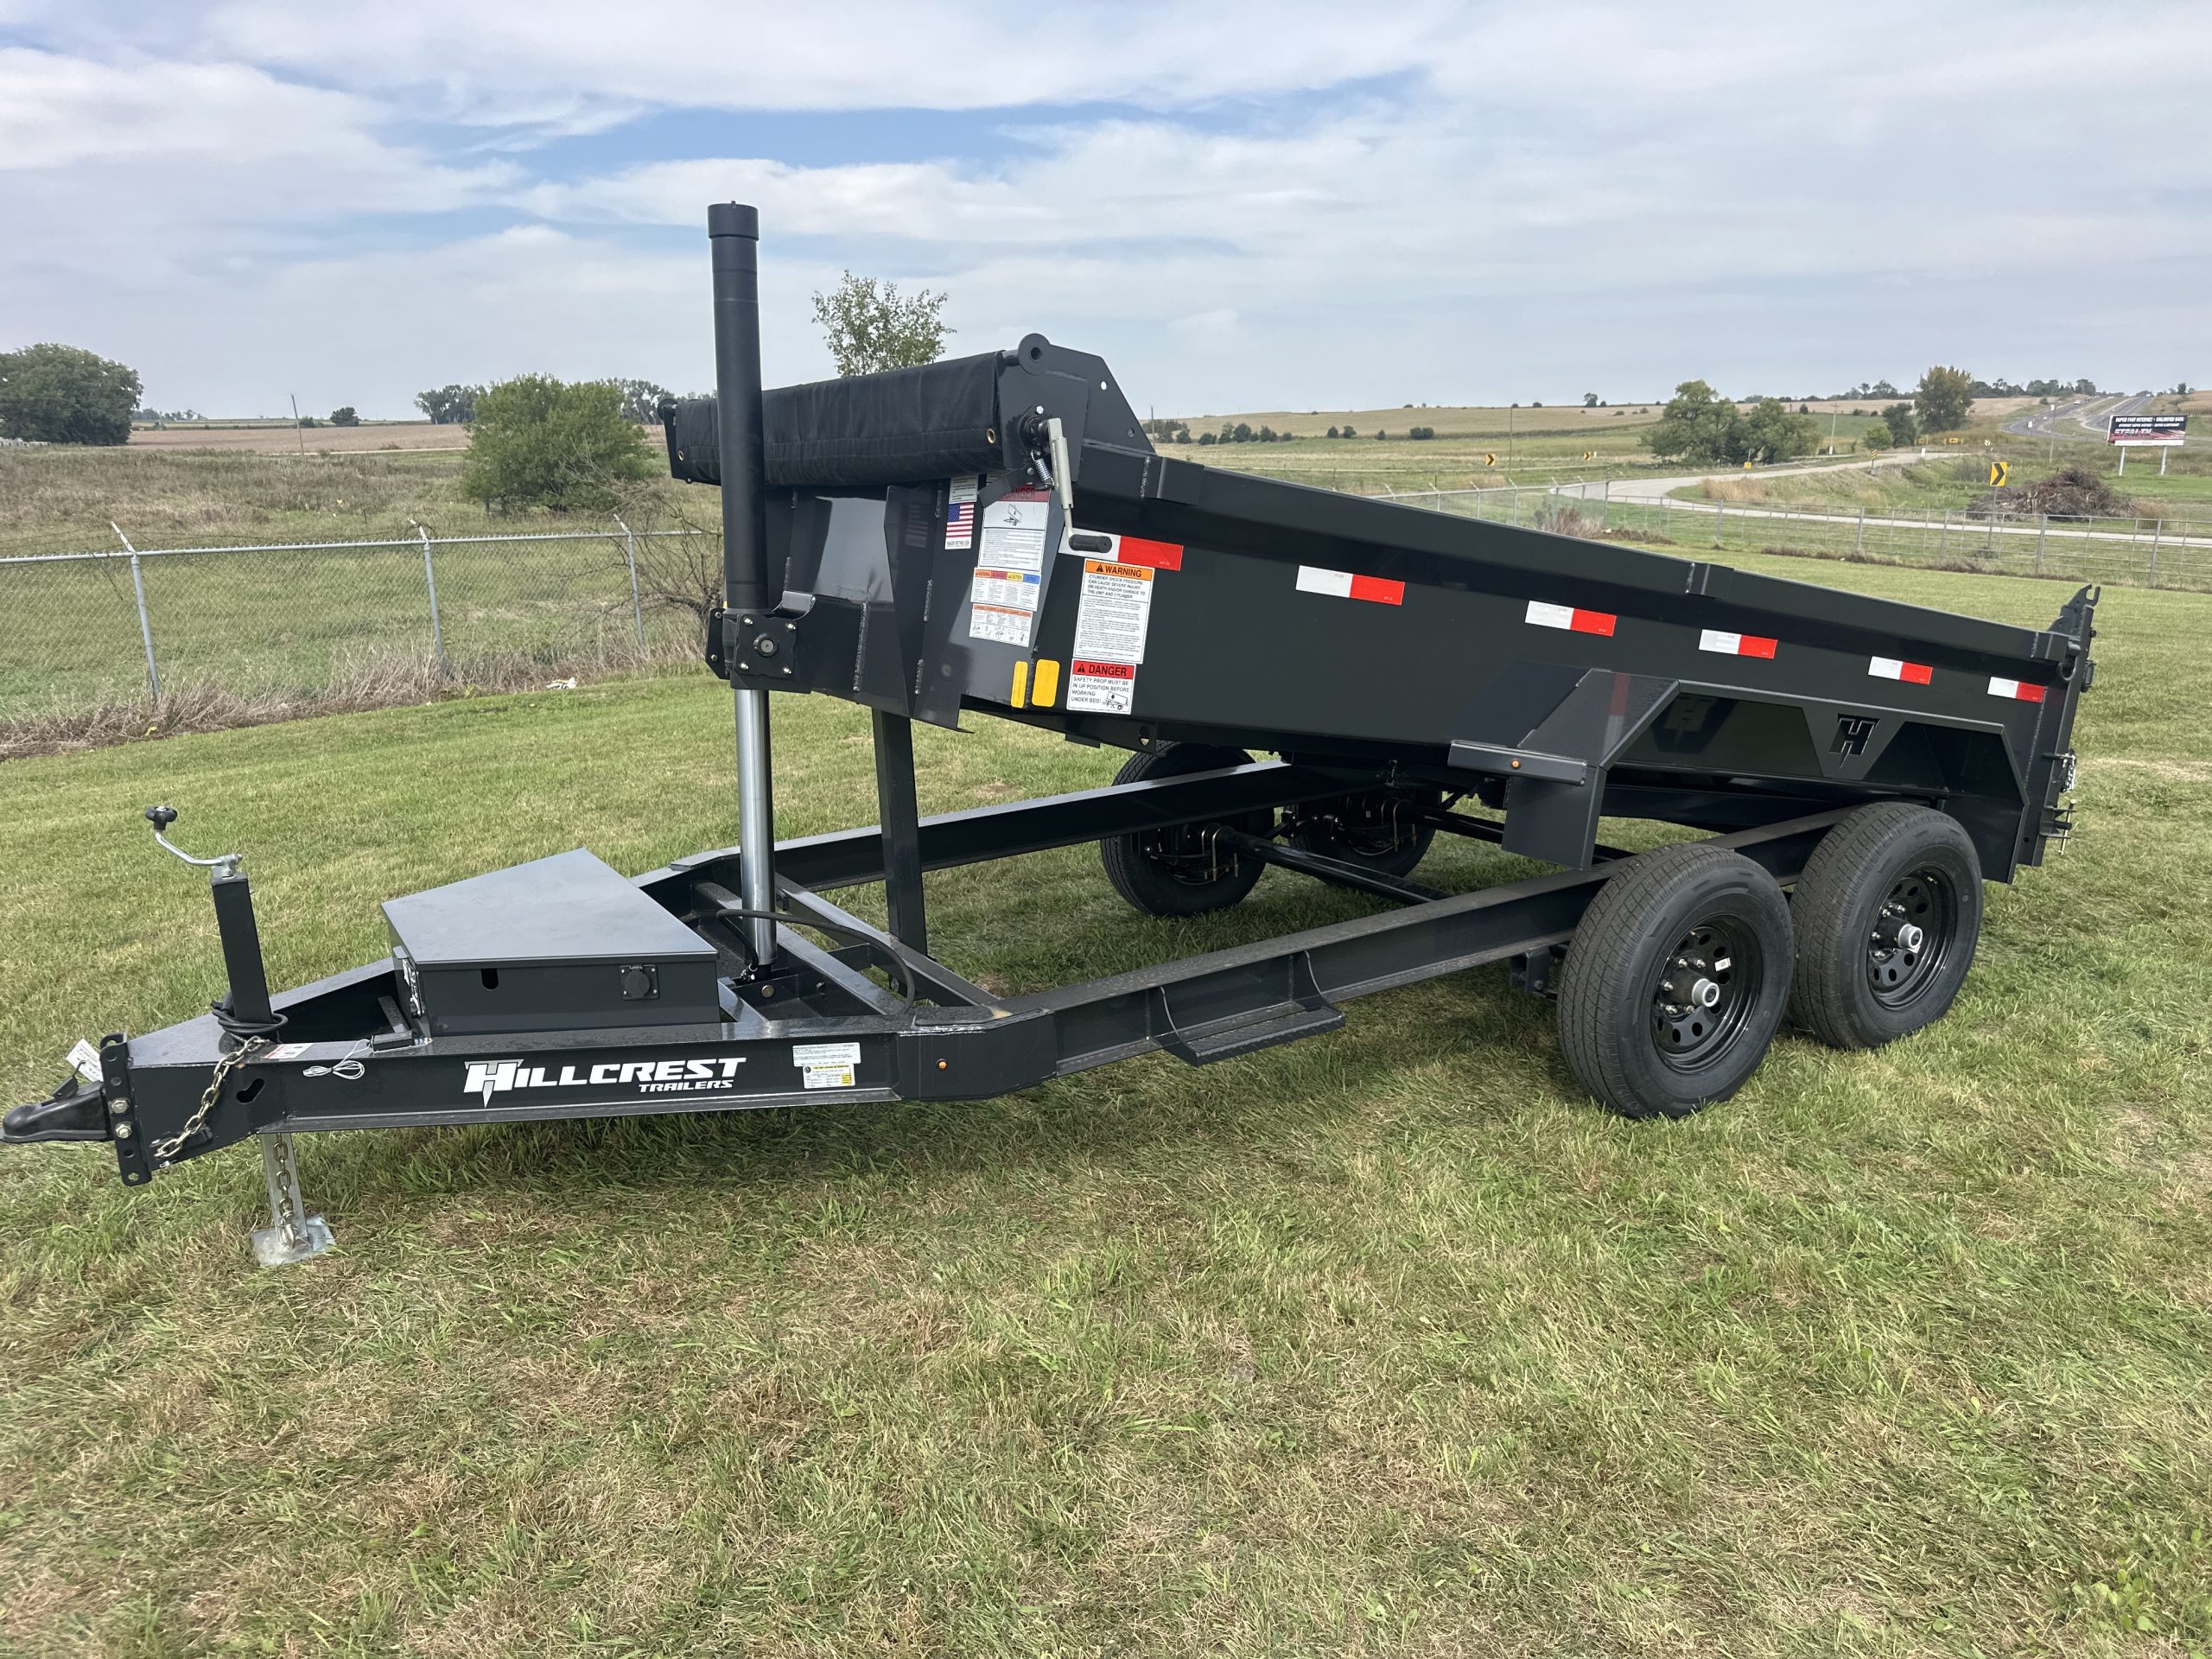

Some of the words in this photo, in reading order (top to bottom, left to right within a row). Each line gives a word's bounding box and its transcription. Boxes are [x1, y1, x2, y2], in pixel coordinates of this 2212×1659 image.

[1105, 565, 1141, 577] WARNING
[1089, 664, 1127, 677] DANGER
[463, 1058, 747, 1108] HILLCREST
[639, 1079, 734, 1093] TRAILERS
